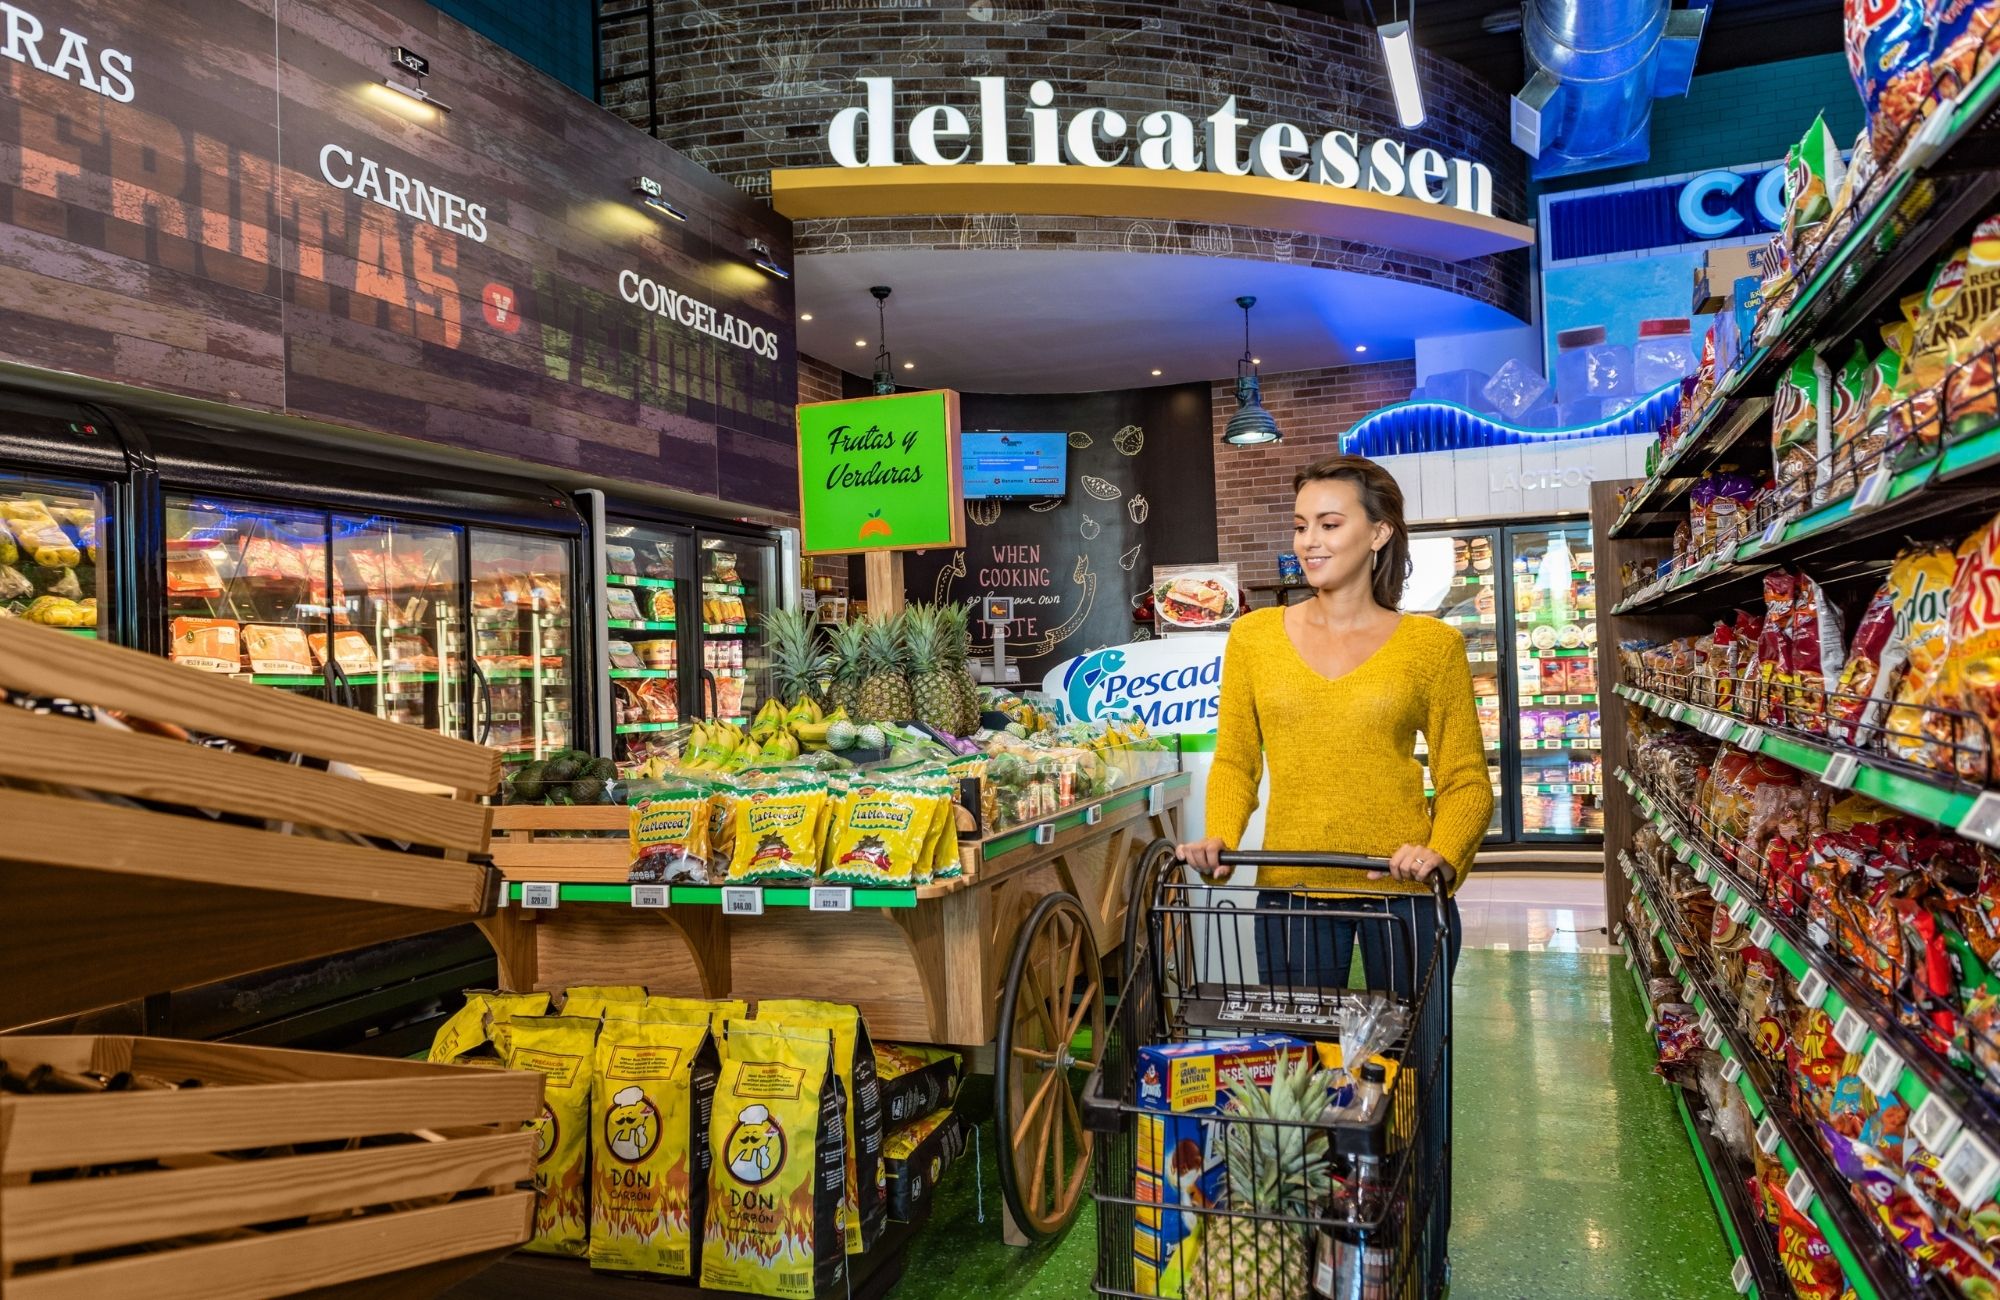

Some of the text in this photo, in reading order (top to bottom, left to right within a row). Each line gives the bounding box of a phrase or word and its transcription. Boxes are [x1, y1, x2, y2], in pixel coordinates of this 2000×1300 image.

[0, 2, 136, 104] RAS
[828, 76, 1495, 218] delicatessen
[319, 143, 488, 244] CARNES
[20, 98, 463, 351] FRUTAS
[618, 269, 779, 362] CONGELADOS
[827, 425, 919, 455] Frutas y
[826, 461, 923, 490] Verduras
[992, 545, 1040, 564] WHEN
[979, 568, 1050, 587] COOKING
[966, 595, 1061, 609] go our own
[977, 617, 1038, 639] TSTE
[1105, 655, 1222, 703] Pescad
[1180, 1073, 1207, 1086] NATURAL
[611, 1168, 651, 1188] DON
[610, 1187, 651, 1202] CARBÓN
[729, 1188, 774, 1210] DON
[728, 1208, 774, 1224] CARBÓN
[1784, 1225, 1808, 1259] PIG
